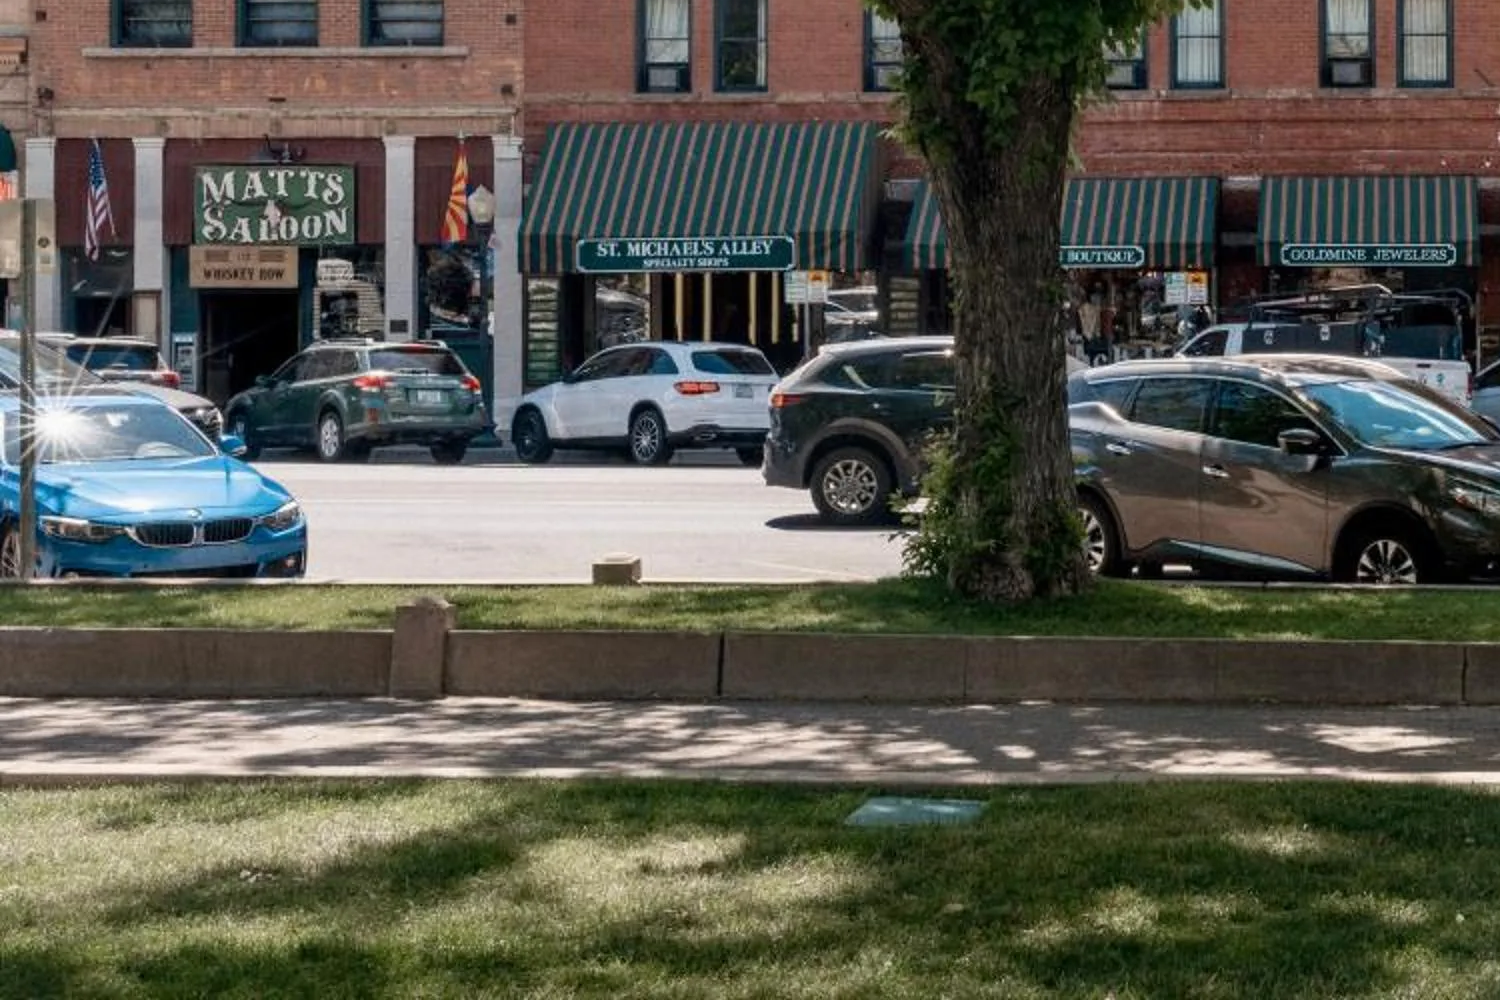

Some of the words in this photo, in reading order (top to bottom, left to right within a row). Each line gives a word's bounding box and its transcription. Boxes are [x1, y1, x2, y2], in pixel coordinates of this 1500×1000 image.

[202, 206, 349, 243] SALOON
[597, 243, 621, 257] ST.
[627, 241, 715, 256] MICHAEL'S
[719, 240, 773, 255] ALLEY
[1067, 250, 1135, 262] BOUTIQUE
[1290, 249, 1366, 261] GOLDMINE
[1373, 249, 1447, 261] JEWELERS
[642, 258, 696, 268] SPECIALTY
[697, 257, 730, 267] SHOPS
